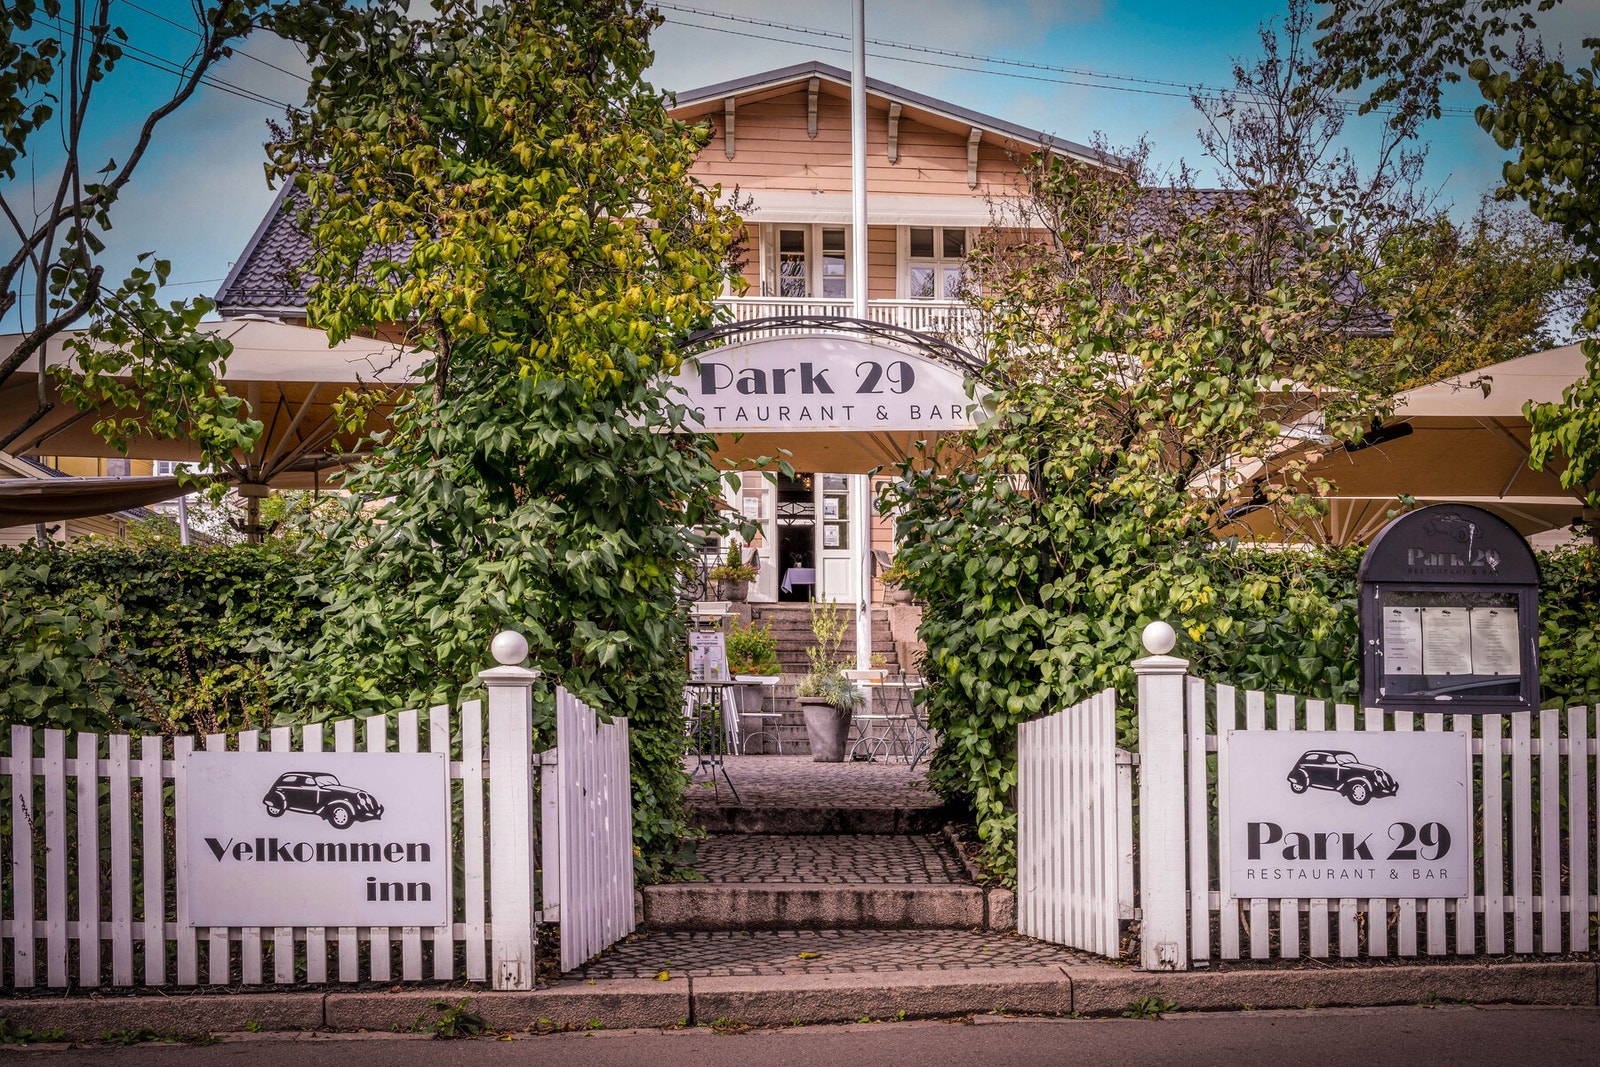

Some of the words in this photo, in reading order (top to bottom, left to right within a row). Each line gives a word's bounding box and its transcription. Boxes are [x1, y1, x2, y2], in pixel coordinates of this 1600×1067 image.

[700, 362, 835, 395] Park
[855, 360, 915, 395] 29
[876, 405, 889, 421] &
[910, 404, 962, 420] BAR
[1407, 547, 1465, 567] Park
[204, 837, 431, 863] Velkommen
[1247, 821, 1374, 861] Park
[1386, 821, 1452, 861] 29
[1247, 868, 1376, 880] RESTAURANT
[1389, 868, 1399, 880] &
[1412, 868, 1448, 880] BAR
[366, 876, 432, 902] inn
